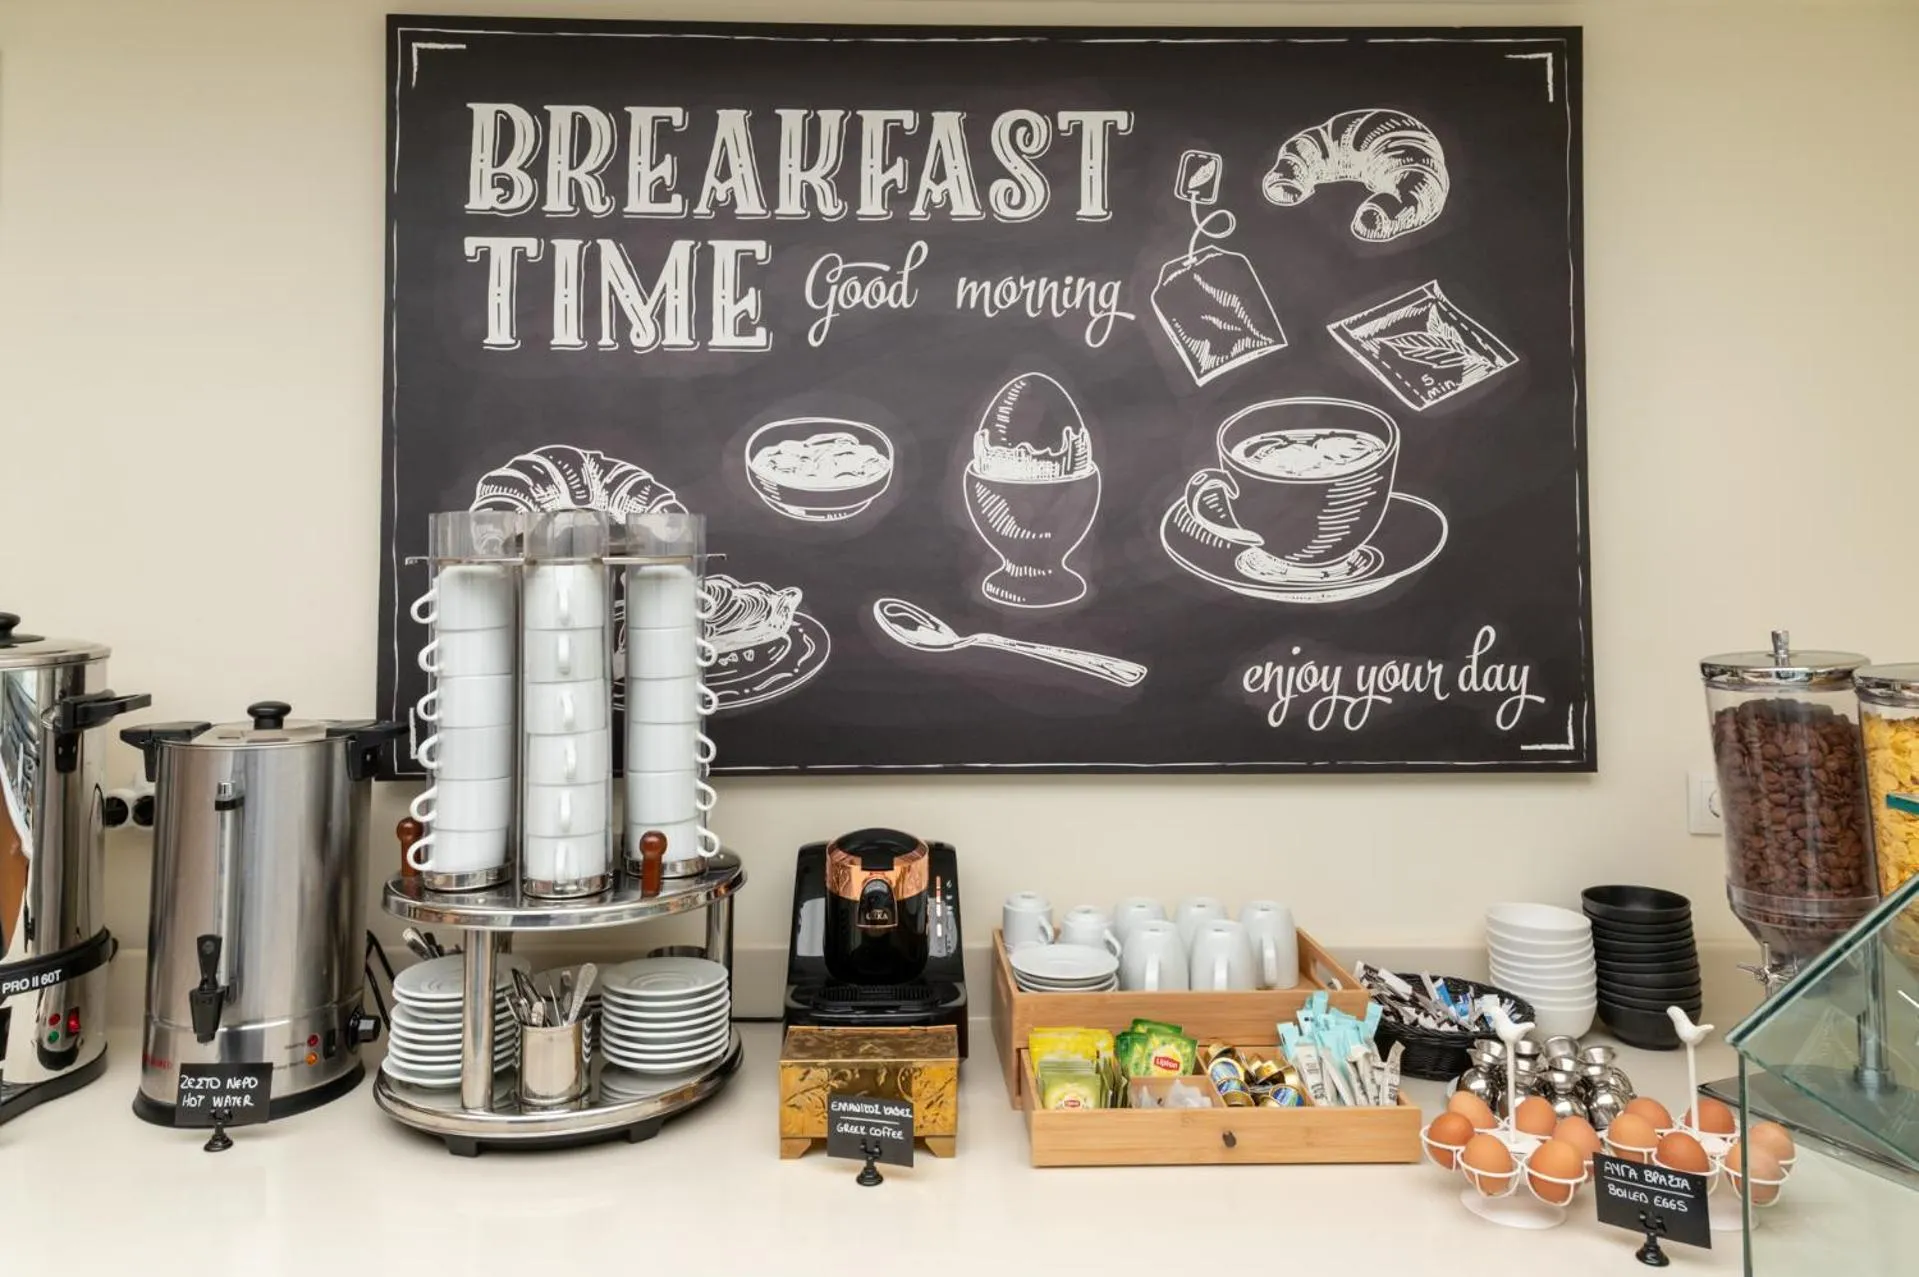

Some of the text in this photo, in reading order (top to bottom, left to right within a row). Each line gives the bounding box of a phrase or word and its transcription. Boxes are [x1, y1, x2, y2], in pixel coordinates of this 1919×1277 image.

[465, 102, 1134, 222] BREAKFAST
[464, 236, 773, 352] TIME
[805, 240, 1135, 347] Good morning
[1421, 374, 1435, 386] 5
[1427, 380, 1456, 399] min
[1243, 625, 1545, 731] enjoy your day
[2, 978, 30, 994] PRO
[40, 968, 62, 985] 60T
[1155, 1058, 1178, 1070] Lipton
[182, 1092, 254, 1108] HOT WATER
[836, 1122, 904, 1140] GREEK COFFEE
[1607, 1183, 1688, 1213] BOILED EGGS
